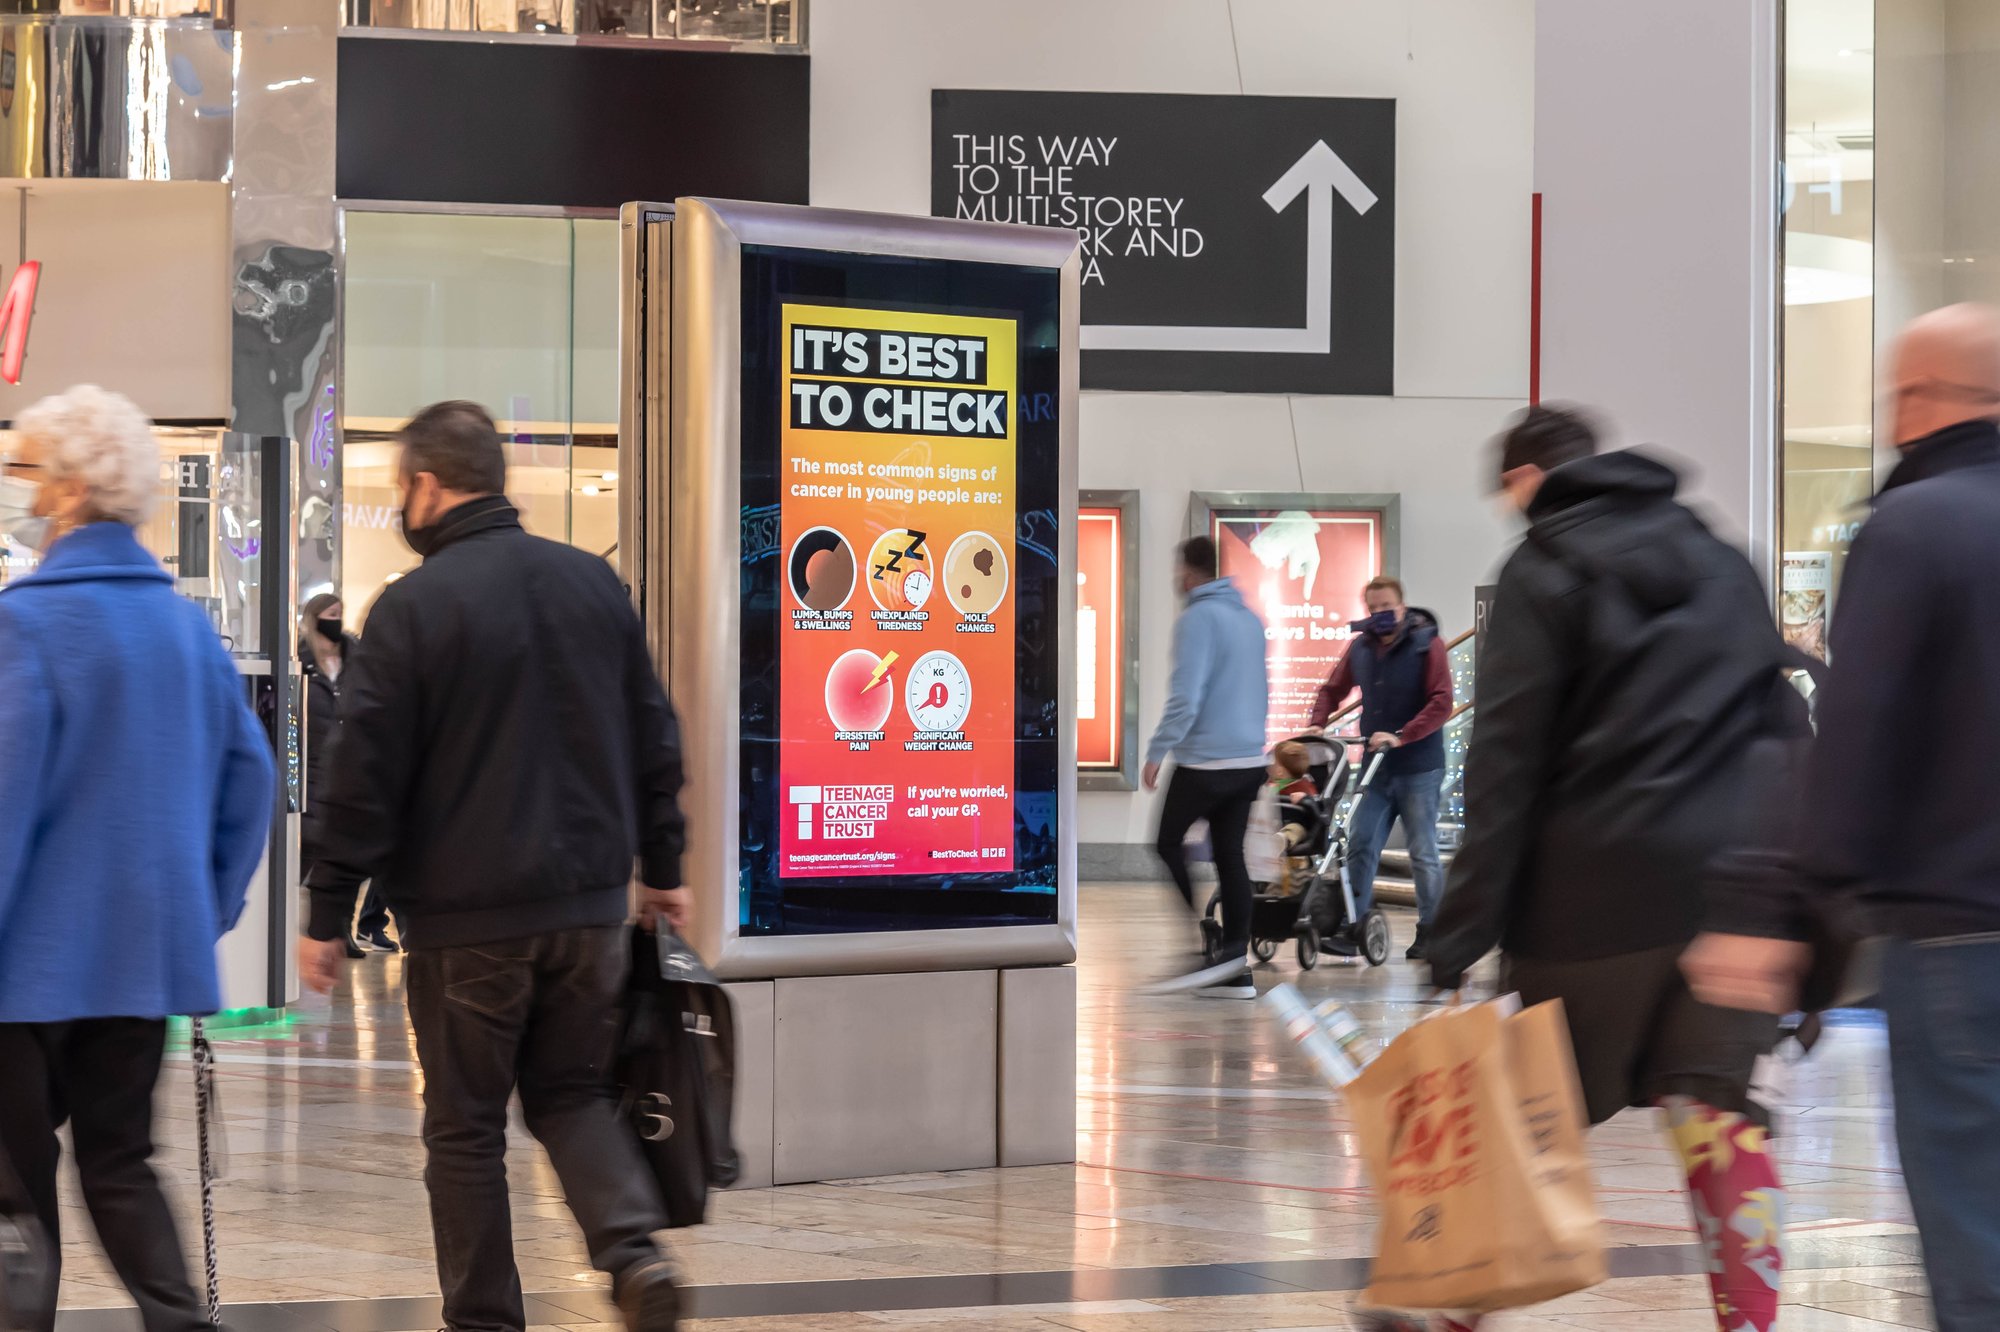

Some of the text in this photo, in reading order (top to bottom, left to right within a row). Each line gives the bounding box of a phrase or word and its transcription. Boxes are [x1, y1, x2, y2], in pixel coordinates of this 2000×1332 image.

[952, 134, 1118, 166] THIS WAY
[952, 164, 1073, 196] TO THE
[955, 194, 1184, 228] MULTI-STOREY
[1077, 226, 1204, 258] RK AND
[1079, 256, 1106, 286] A
[793, 328, 985, 380] IT'S BEST
[791, 383, 1006, 434] TO CHECK
[790, 457, 998, 483] The most common signs of
[790, 482, 1003, 505] cancer in young people are:
[791, 609, 853, 620] LUMPS, BUMPS
[870, 611, 929, 621] UNEXPLAINED
[964, 613, 987, 623] MOLE
[794, 620, 851, 630] & SWELLINGS
[877, 621, 923, 631] TIREDNESS
[955, 623, 996, 633] CHANGES
[1264, 621, 1351, 640] ows best
[933, 668, 945, 677] KG
[834, 731, 885, 741] PERSISTENT
[912, 731, 965, 741] SIGNIFICANT
[849, 741, 870, 751] PAIN
[904, 741, 973, 751] WEIGHT CHANGE
[824, 786, 893, 802] TEENAGE
[907, 784, 1009, 801] If you're worried,
[824, 804, 886, 819] CANCER
[907, 804, 981, 820] call your GP.
[824, 822, 873, 837] TRUST
[789, 851, 896, 863] teenagecancertrust.org/signs
[927, 849, 979, 859] #BestToCheck
